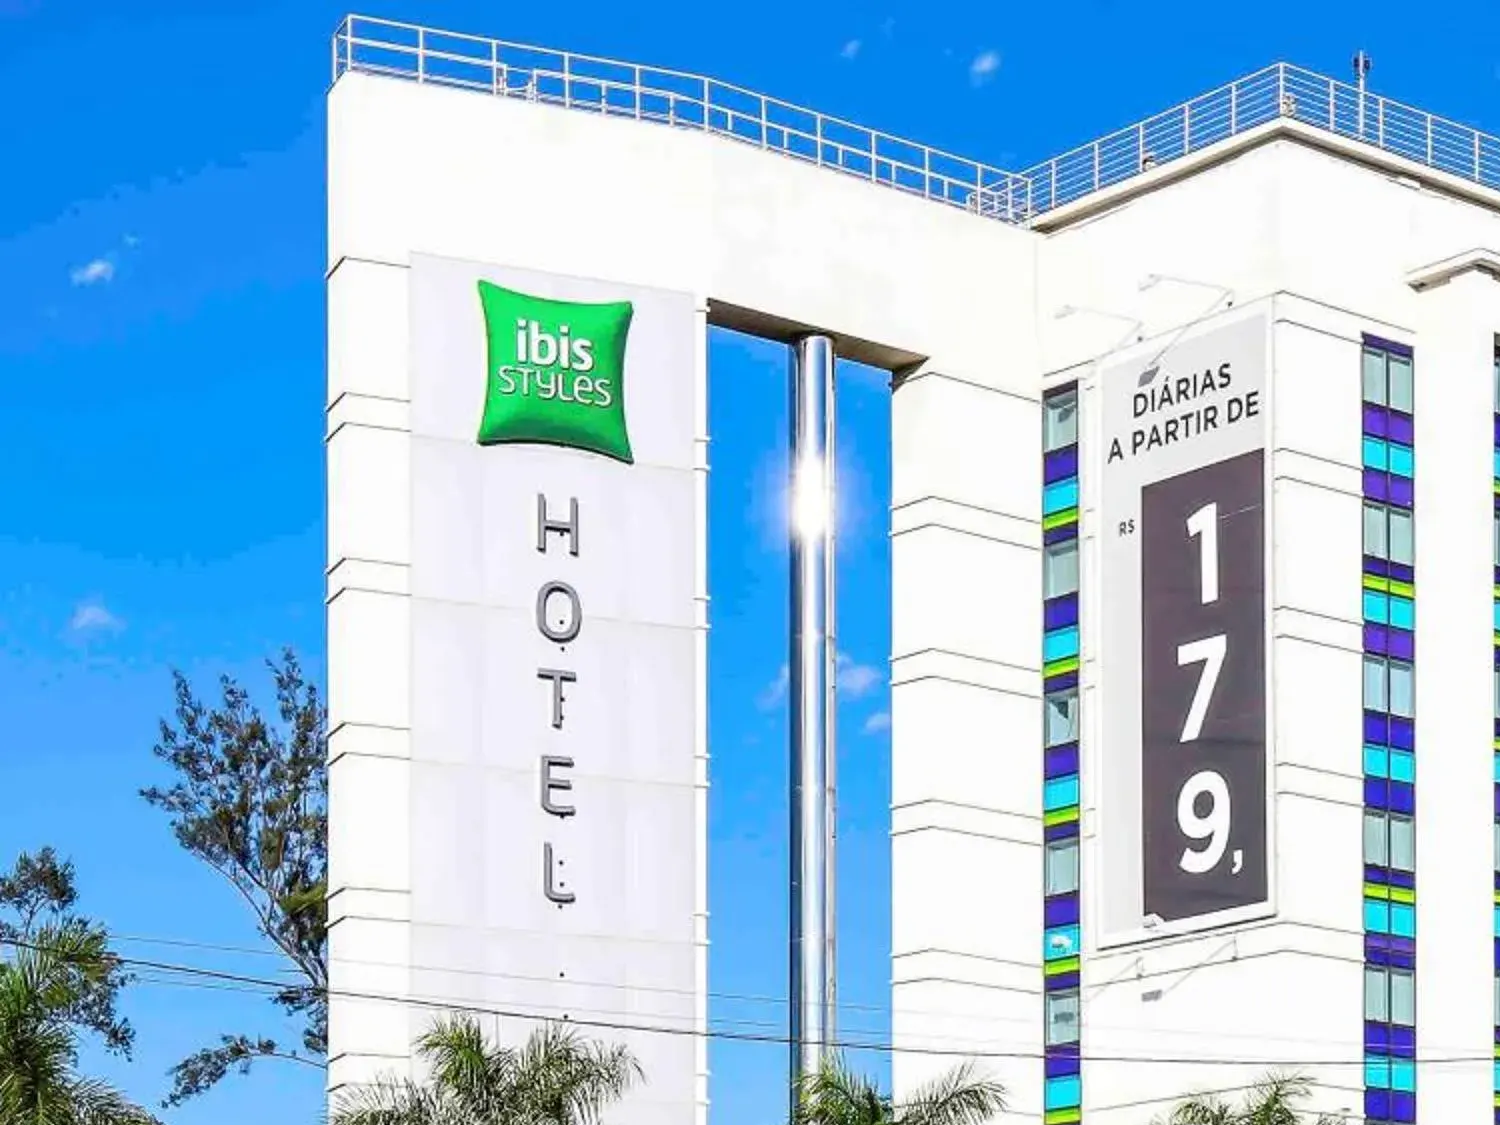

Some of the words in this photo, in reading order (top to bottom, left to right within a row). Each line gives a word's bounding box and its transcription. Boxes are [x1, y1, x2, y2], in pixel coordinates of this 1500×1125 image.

[516, 319, 594, 371] ibis
[1133, 363, 1231, 419] DIÁRIAS
[1107, 437, 1124, 465] A
[1131, 405, 1219, 455] PARTIR
[1227, 390, 1260, 424] DE
[1119, 518, 1135, 537] R$
[536, 493, 583, 905] HOTEL
